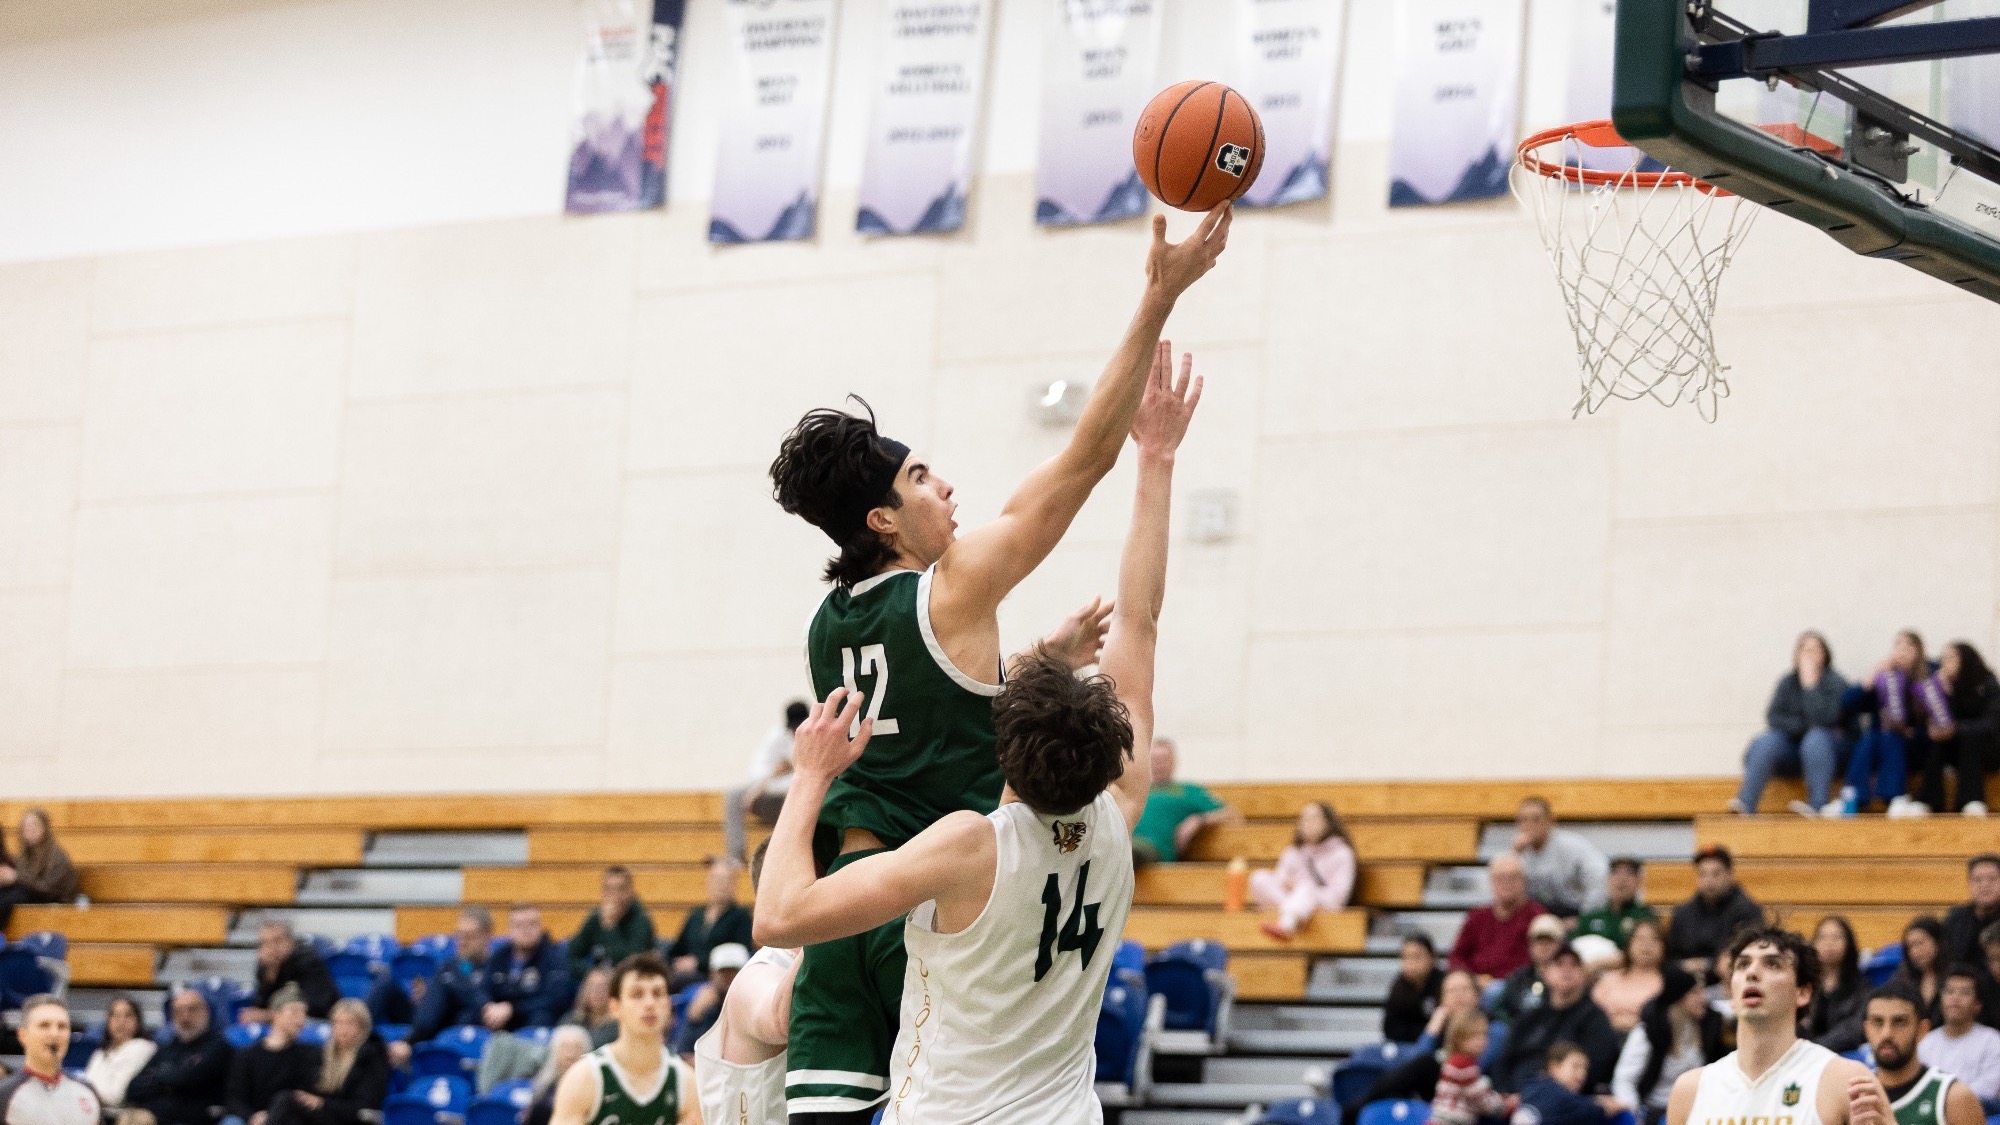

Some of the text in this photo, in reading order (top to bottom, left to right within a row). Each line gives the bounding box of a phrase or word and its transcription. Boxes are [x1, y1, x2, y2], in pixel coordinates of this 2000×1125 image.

[1226, 146, 1240, 172] SPORTS
[841, 643, 900, 738] 12
[1034, 859, 1104, 982] 14
